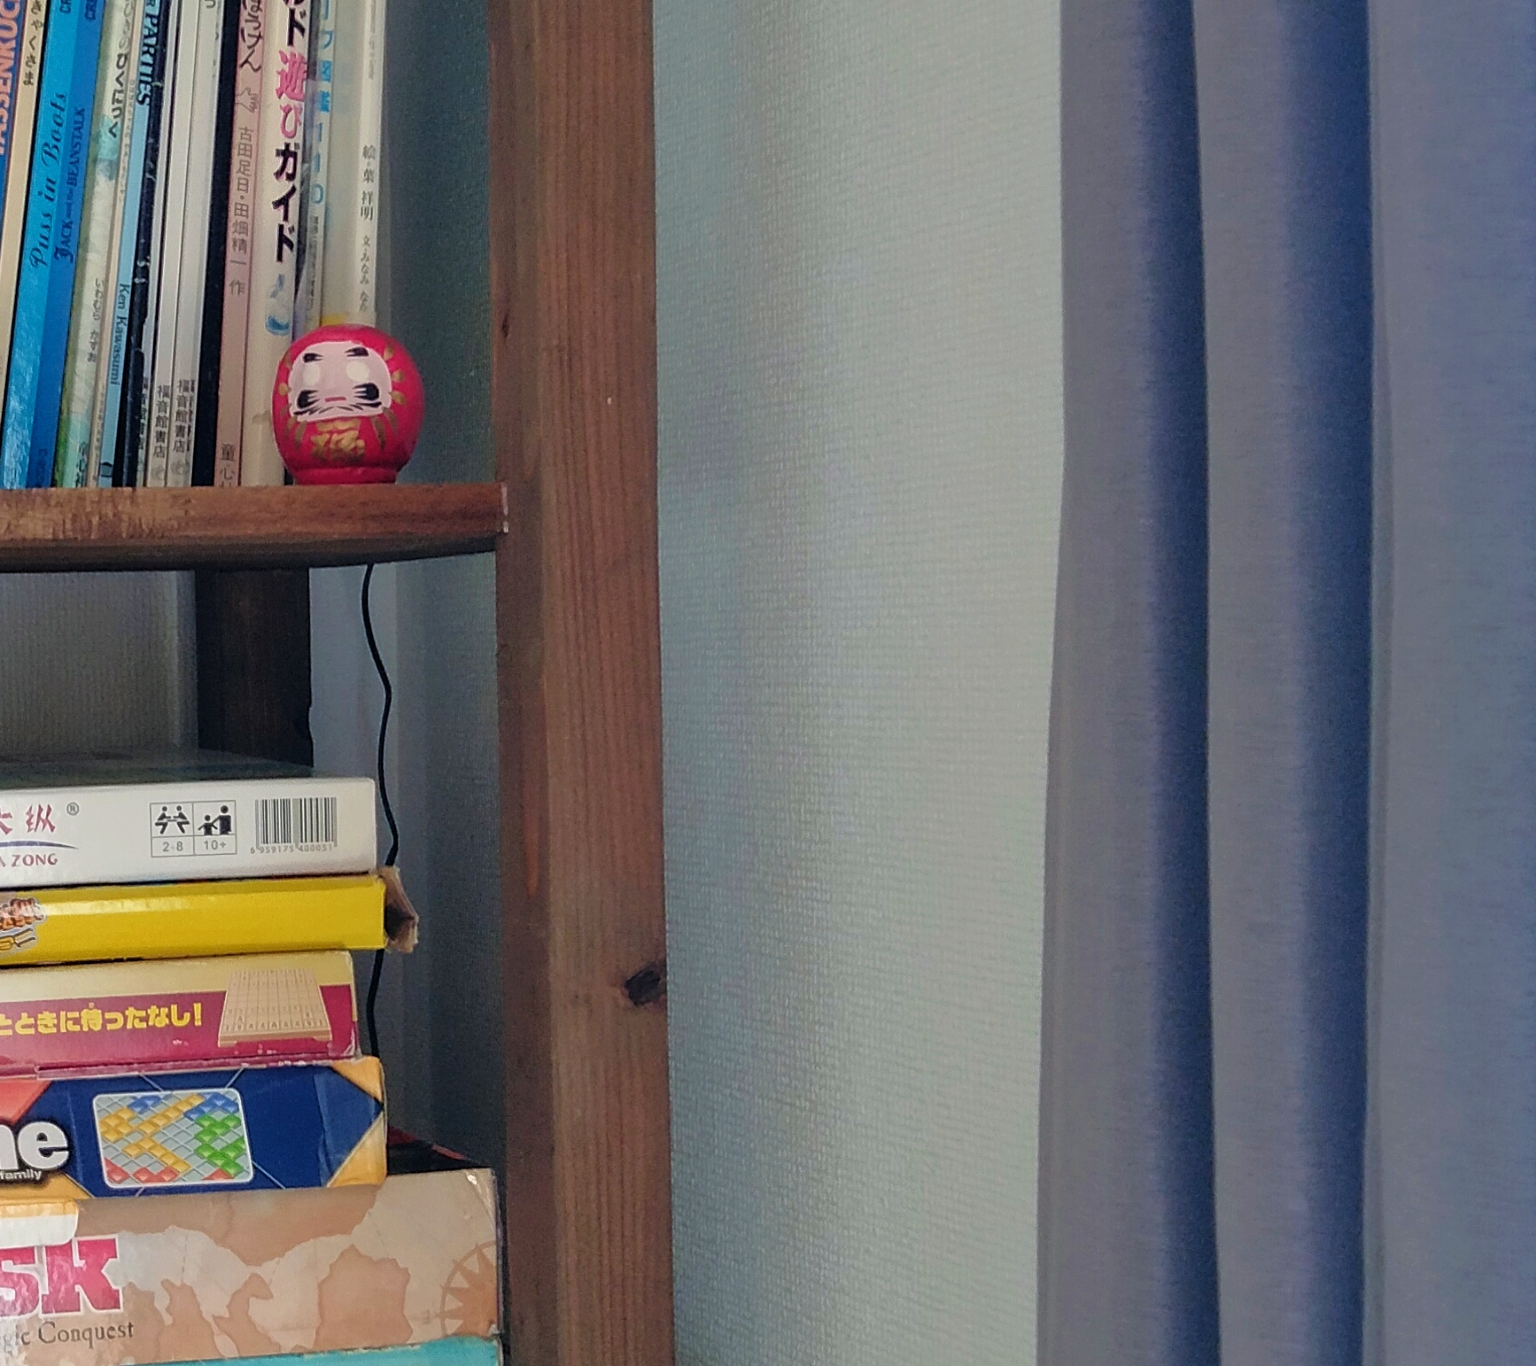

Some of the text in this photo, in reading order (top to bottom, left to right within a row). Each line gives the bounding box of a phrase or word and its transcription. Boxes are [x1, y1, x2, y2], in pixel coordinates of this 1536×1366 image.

[136, 14, 160, 107] PARTIES
[29, 91, 67, 269] Puss in Boots
[66, 106, 86, 187] BEANSTALK
[110, 282, 131, 386] Ken Kawasumi
[153, 384, 171, 459] 福音館書店
[10, 852, 59, 868] ZONG
[202, 839, 228, 852] 10+
[0, 1169, 43, 1184] family
[37, 1320, 135, 1349] Conquest
